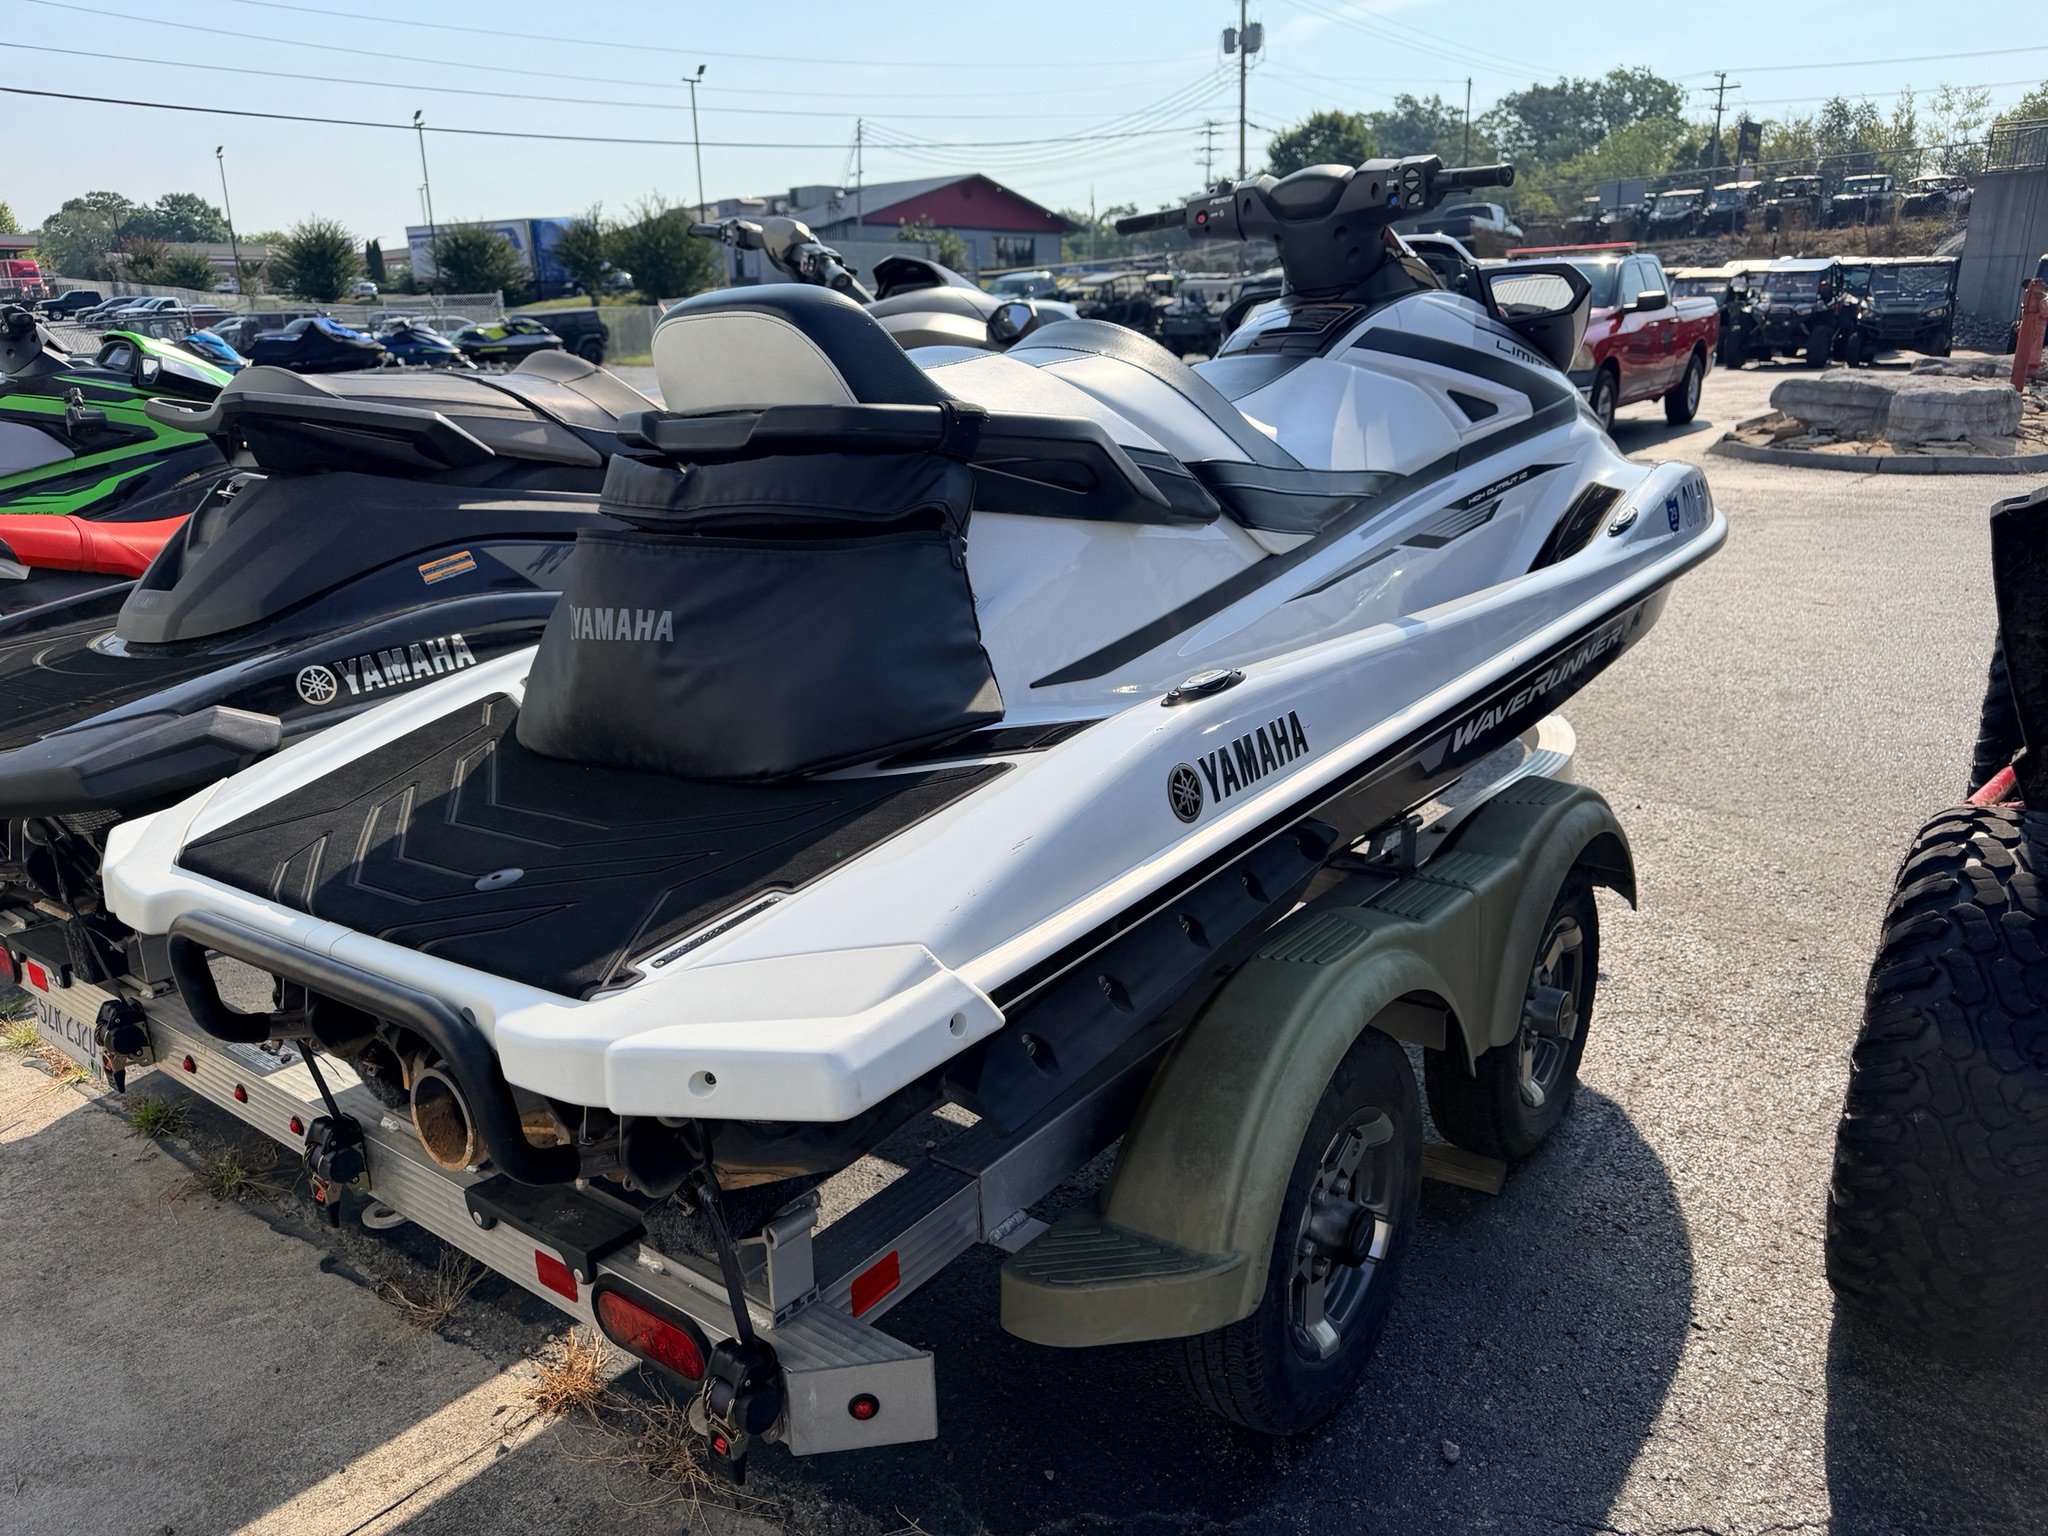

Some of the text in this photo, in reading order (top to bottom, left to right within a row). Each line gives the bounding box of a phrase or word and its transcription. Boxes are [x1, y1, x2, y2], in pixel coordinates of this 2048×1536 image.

[1496, 340, 1552, 368] LIMIT
[573, 607, 674, 642] YAMAHA
[333, 633, 477, 696] YAMAHA
[1453, 624, 1624, 754] WAVERUNNER
[1197, 709, 1310, 804] YAMAHA
